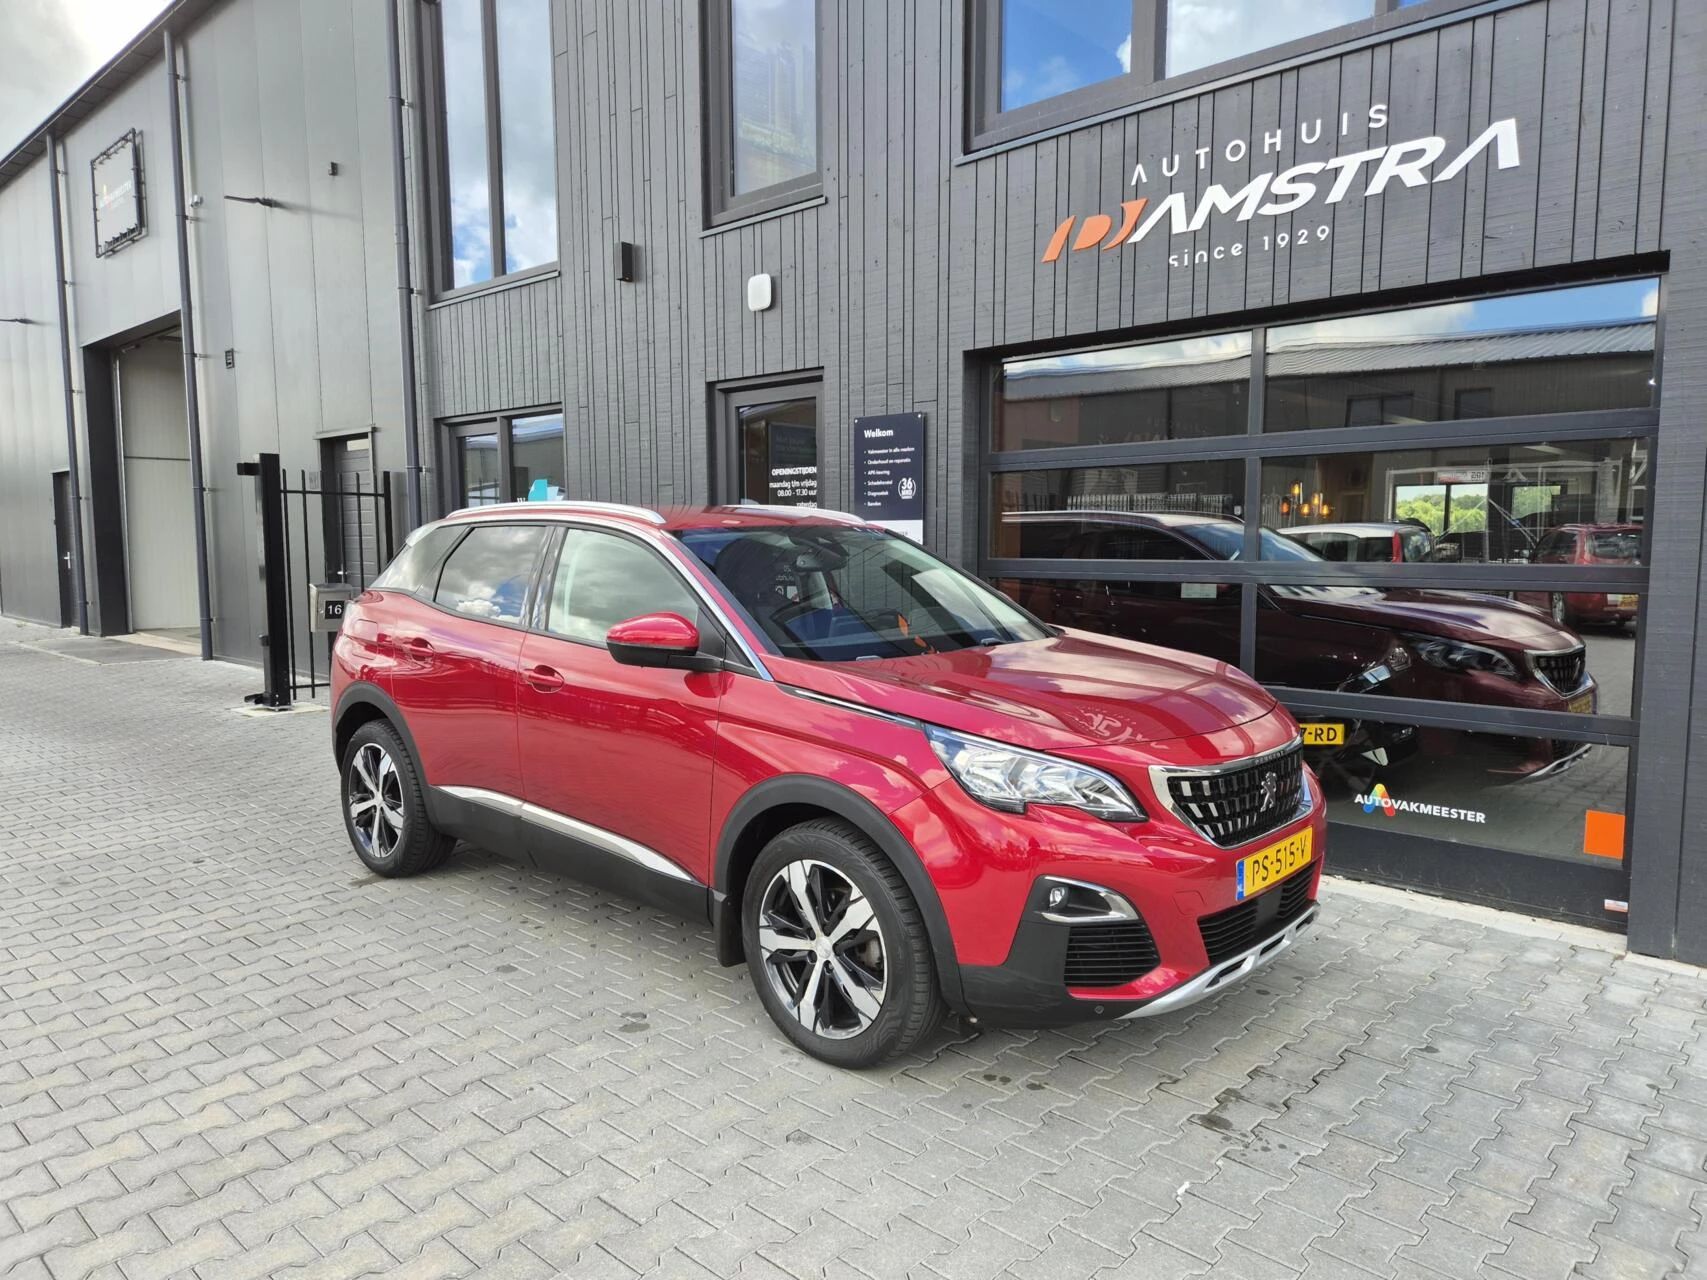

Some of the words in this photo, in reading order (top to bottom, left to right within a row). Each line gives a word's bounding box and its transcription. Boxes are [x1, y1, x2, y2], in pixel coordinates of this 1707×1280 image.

[1131, 104, 1388, 187] AUTOHUIS
[1168, 242, 1244, 267] since
[1263, 225, 1331, 251] 1929
[864, 428, 894, 438] Welkom
[771, 466, 817, 476] OPENINGSTIJDEN
[769, 480, 791, 489] maandag
[800, 478, 817, 488] vrijdag
[901, 477, 913, 490] 36
[777, 489, 792, 497] 08.00
[796, 488, 808, 496] 17.30
[327, 604, 342, 615] 16
[1354, 793, 1486, 824] AUTOVAKMEESTER
[1252, 834, 1307, 887] PS-515-V
